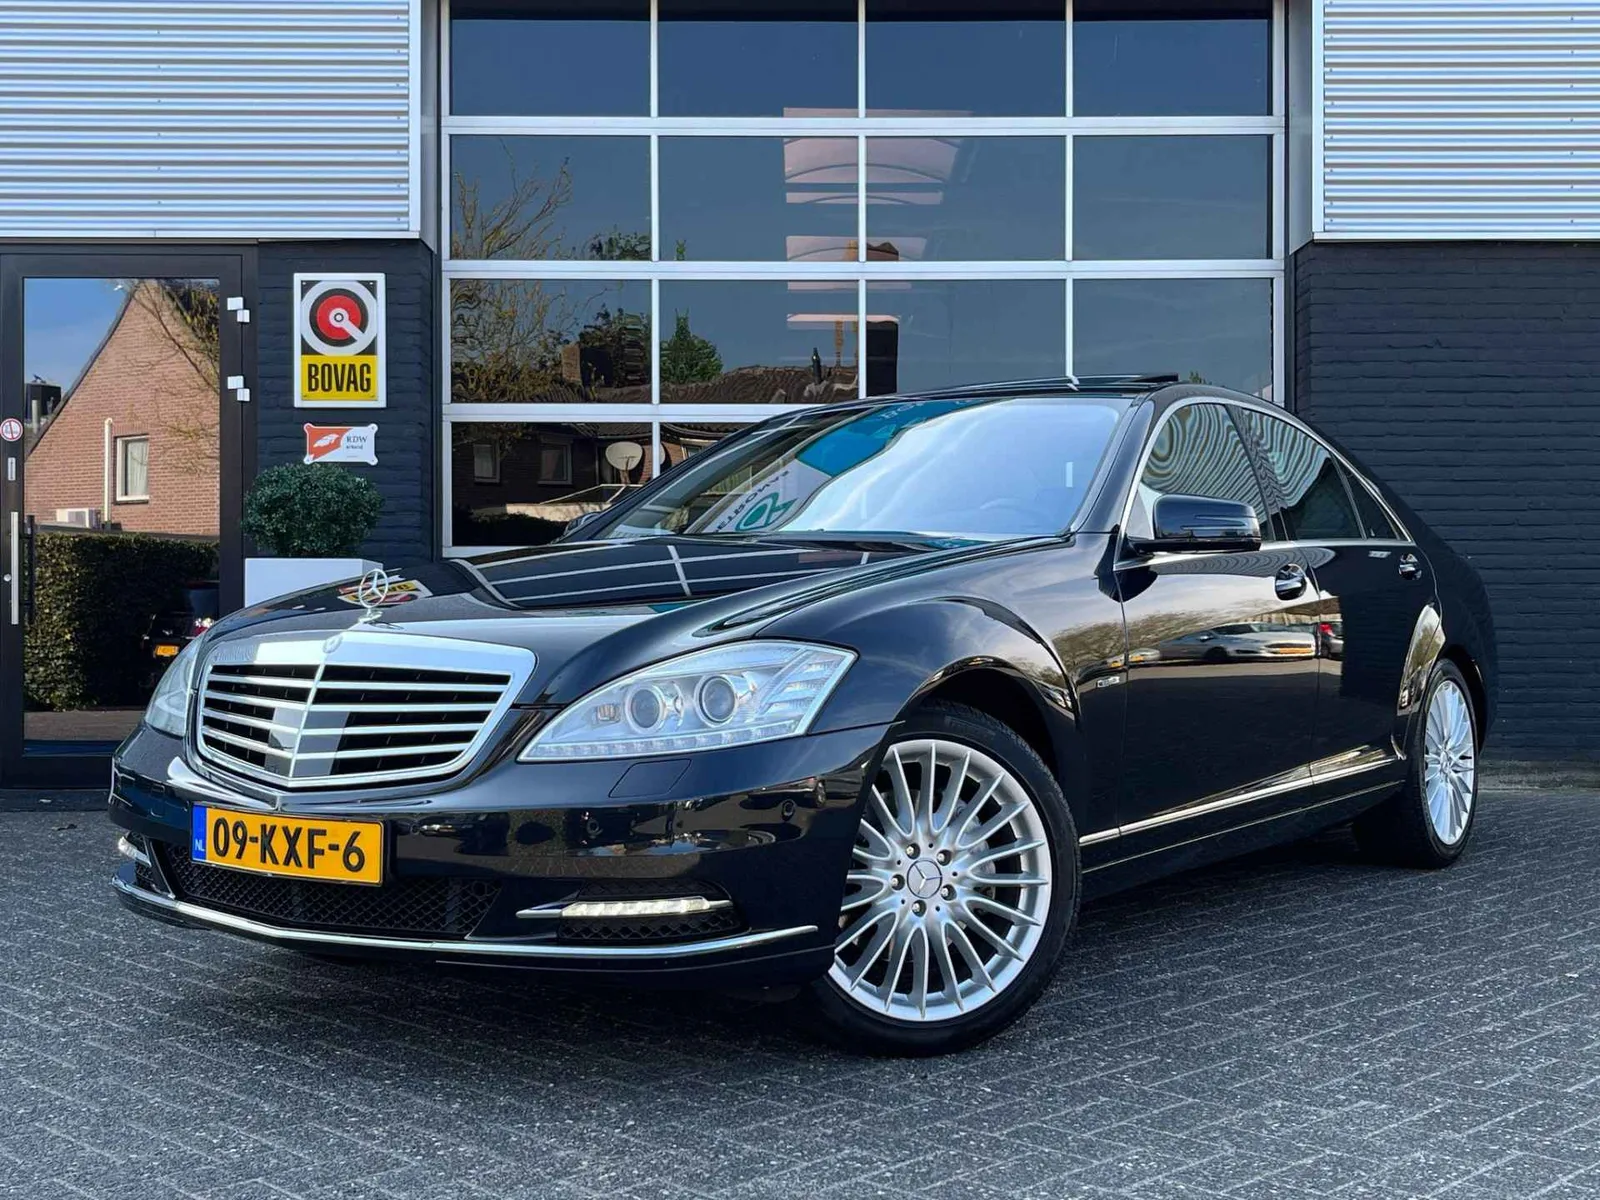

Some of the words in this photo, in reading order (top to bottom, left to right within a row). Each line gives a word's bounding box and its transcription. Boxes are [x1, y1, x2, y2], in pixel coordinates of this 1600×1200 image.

[307, 363, 371, 392] BOVAG
[347, 435, 368, 443] RDW
[194, 838, 205, 852] NL
[213, 817, 366, 873] 09-KXF-6
